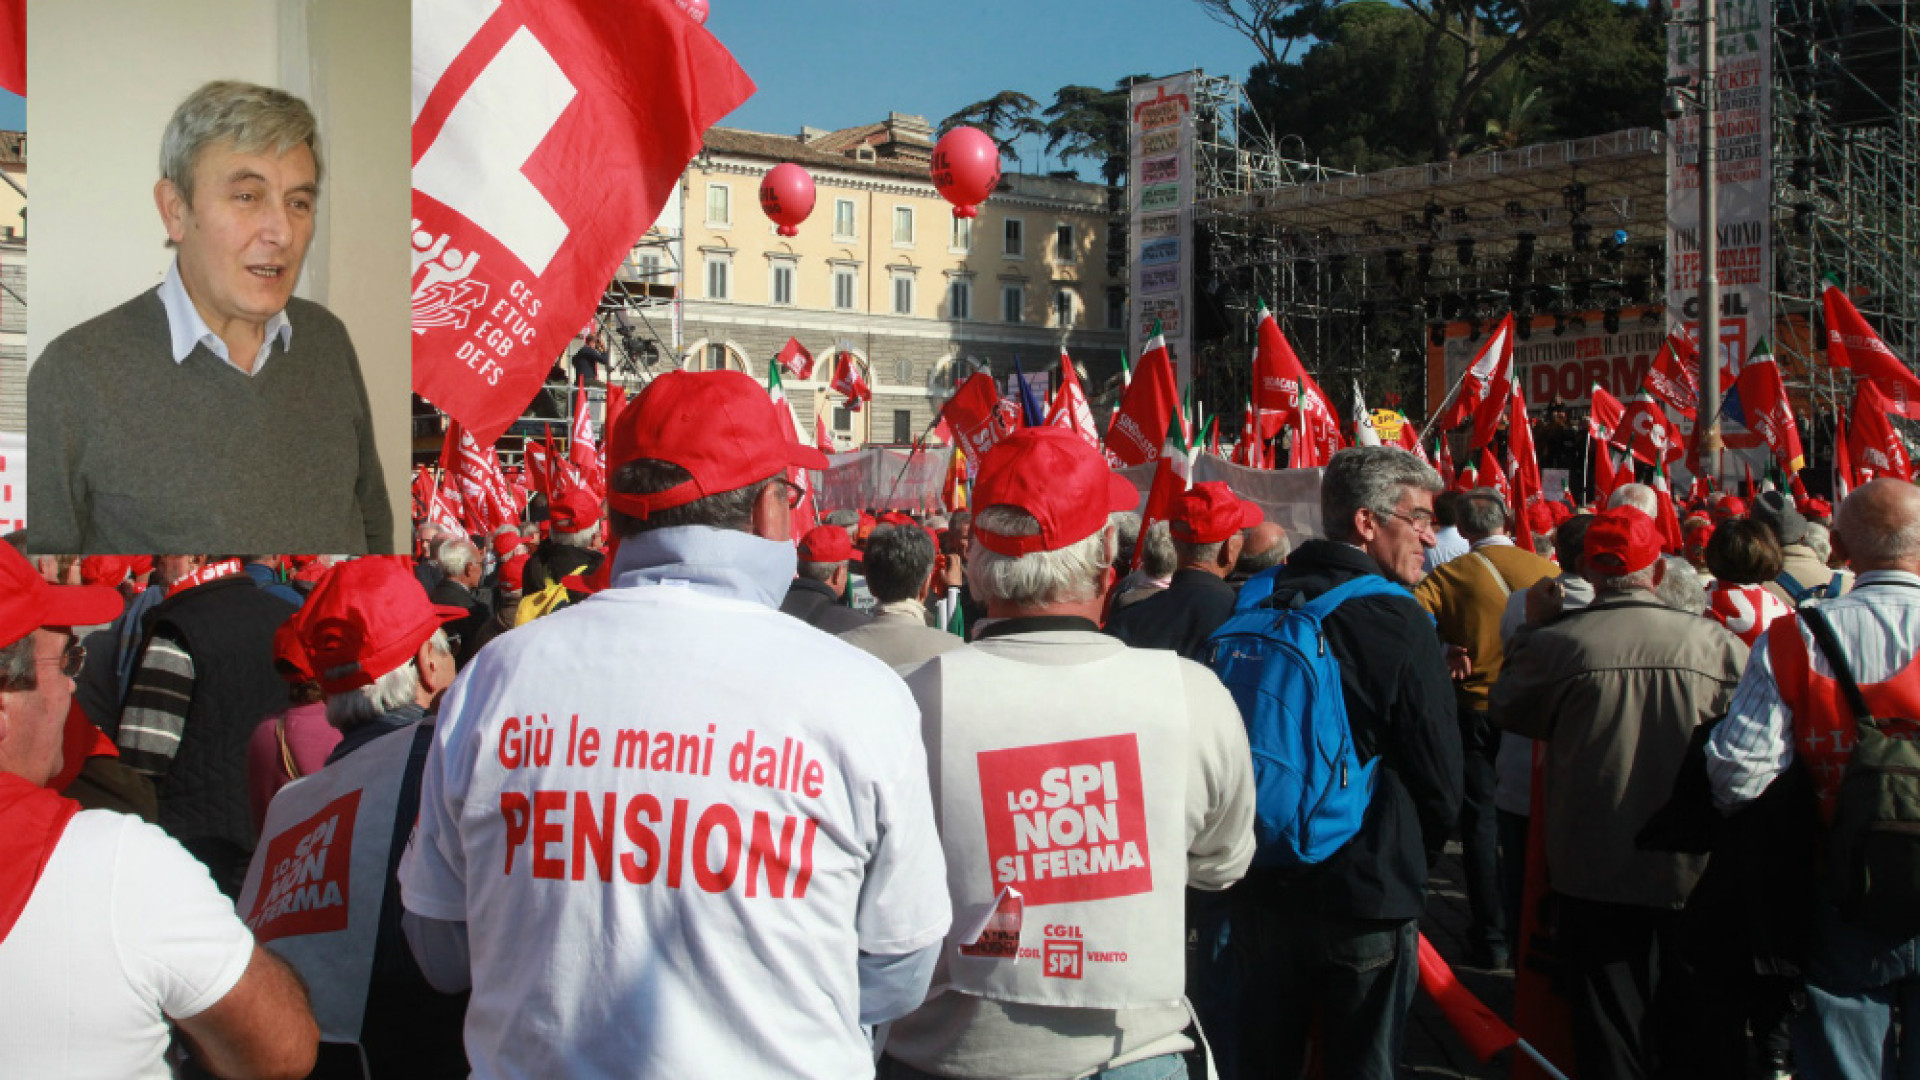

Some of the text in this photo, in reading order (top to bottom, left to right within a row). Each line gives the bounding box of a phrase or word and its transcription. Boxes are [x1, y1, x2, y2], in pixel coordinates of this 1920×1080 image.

[509, 279, 543, 317] CES
[474, 322, 514, 358] EGB
[491, 299, 537, 346] ETUC
[456, 340, 504, 386] DEFS
[498, 713, 824, 798] Giù le mani dalle
[1007, 761, 1118, 811] LO SPI
[295, 814, 338, 857] SPI
[500, 790, 819, 899] PENSIONI
[1013, 802, 1120, 852] NON
[996, 841, 1145, 883] SI FERMA
[1043, 924, 1083, 939] CGIL
[1049, 953, 1078, 975] SPI
[1087, 951, 1127, 962] VENETO
